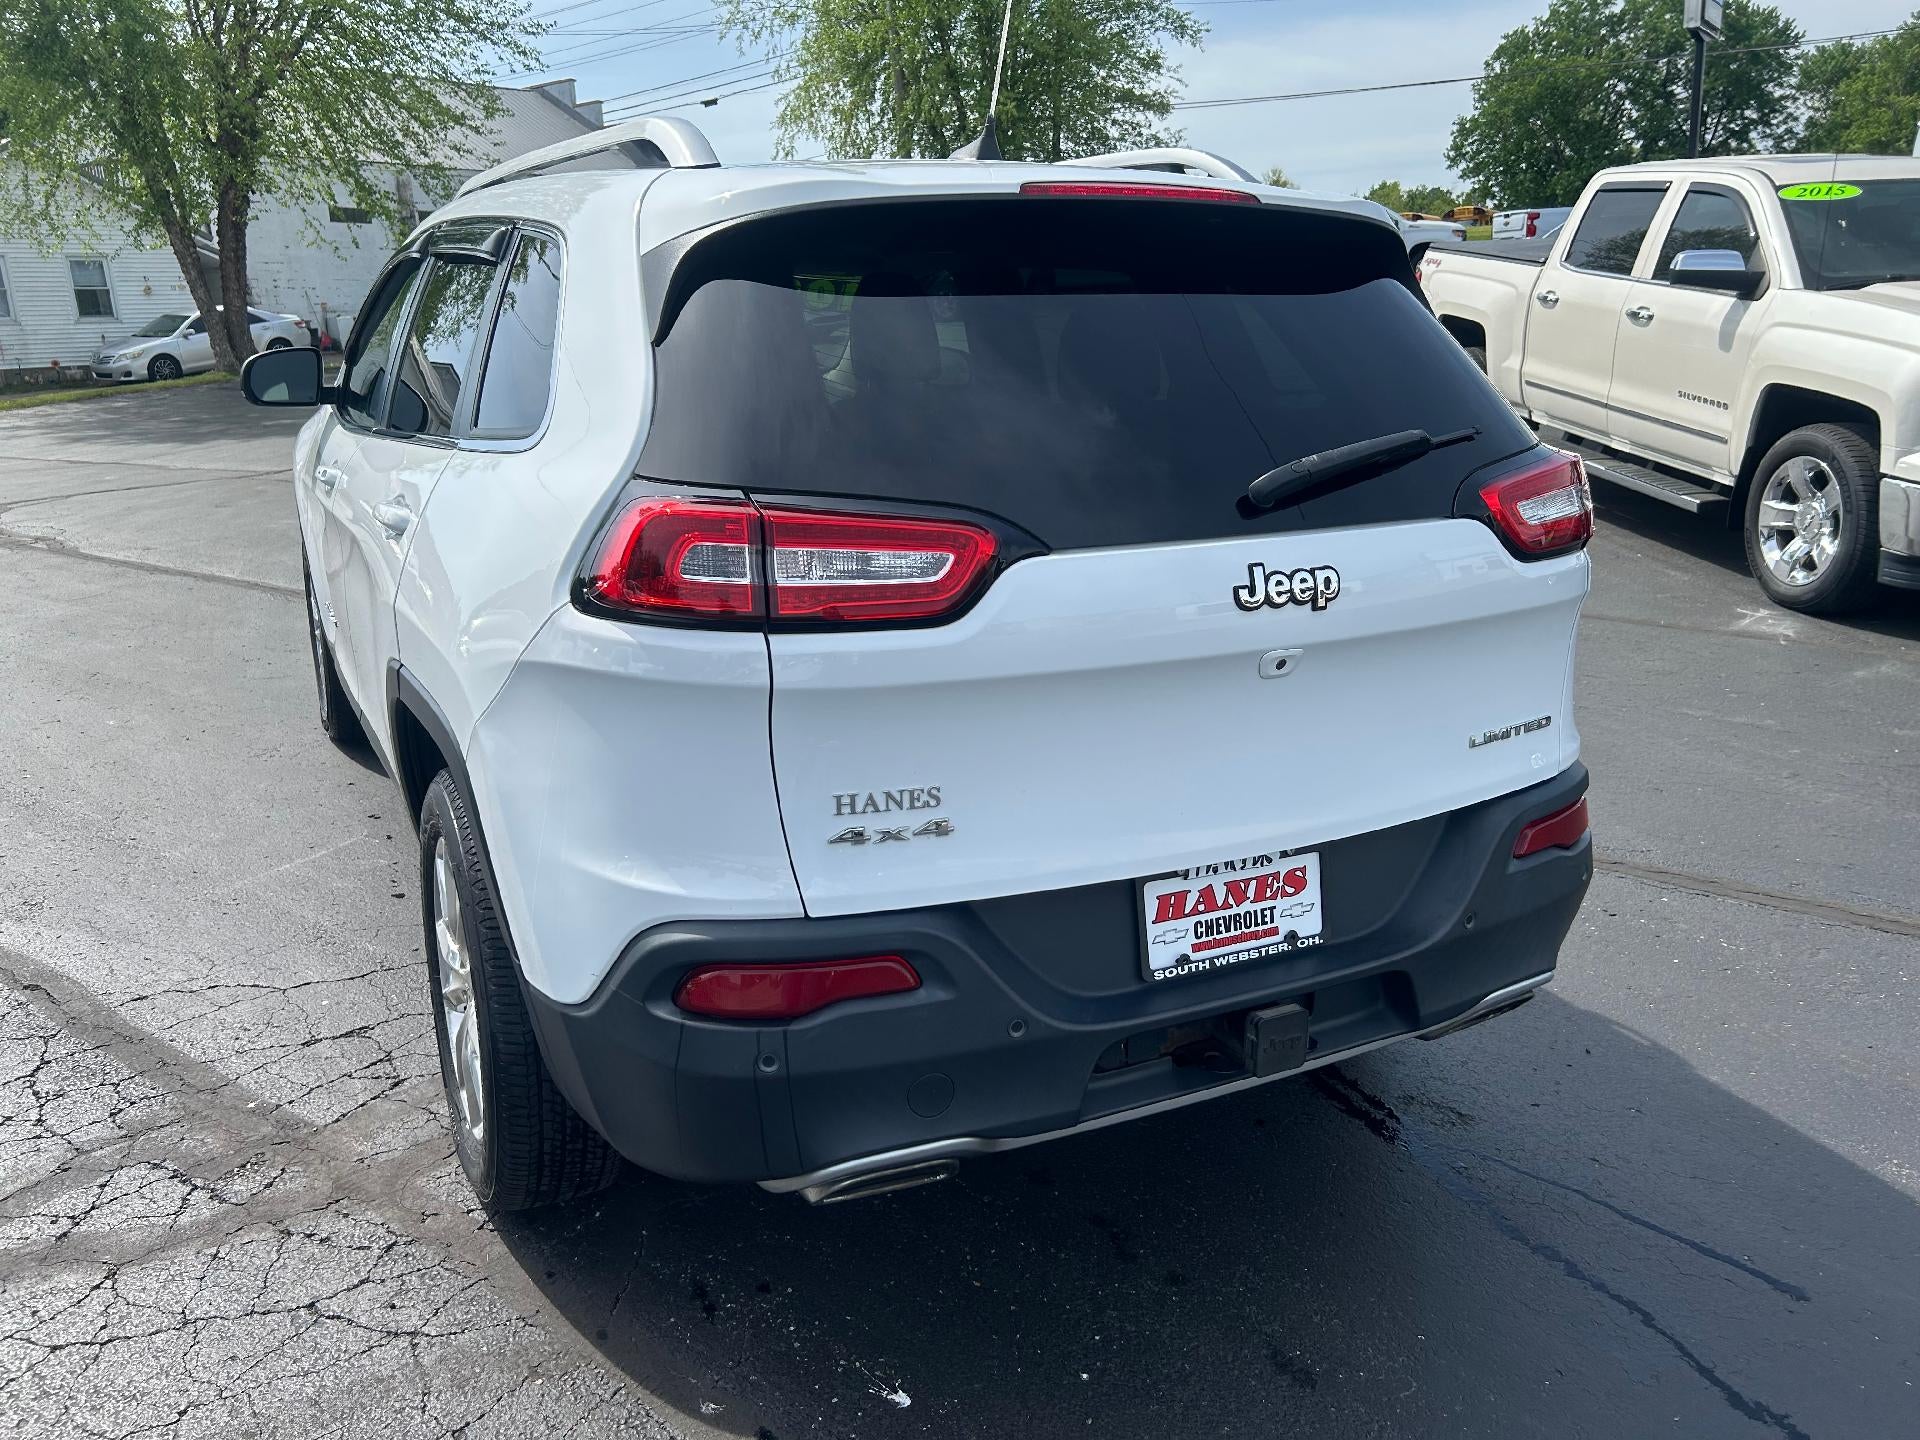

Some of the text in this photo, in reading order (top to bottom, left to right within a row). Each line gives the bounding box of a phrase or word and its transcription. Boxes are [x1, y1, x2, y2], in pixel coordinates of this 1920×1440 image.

[1796, 186, 1846, 198] 2015
[1677, 389, 1729, 411] SILVERADO
[1232, 561, 1341, 612] Jeep
[1468, 715, 1552, 749] LIMITED
[832, 784, 942, 816] HANES
[1152, 864, 1308, 925] HANES
[1191, 926, 1280, 953] www.haneschevy.com
[1193, 905, 1277, 940] CHEVROLET
[1153, 934, 1325, 981] SOUTH WEBSTER, OH.
